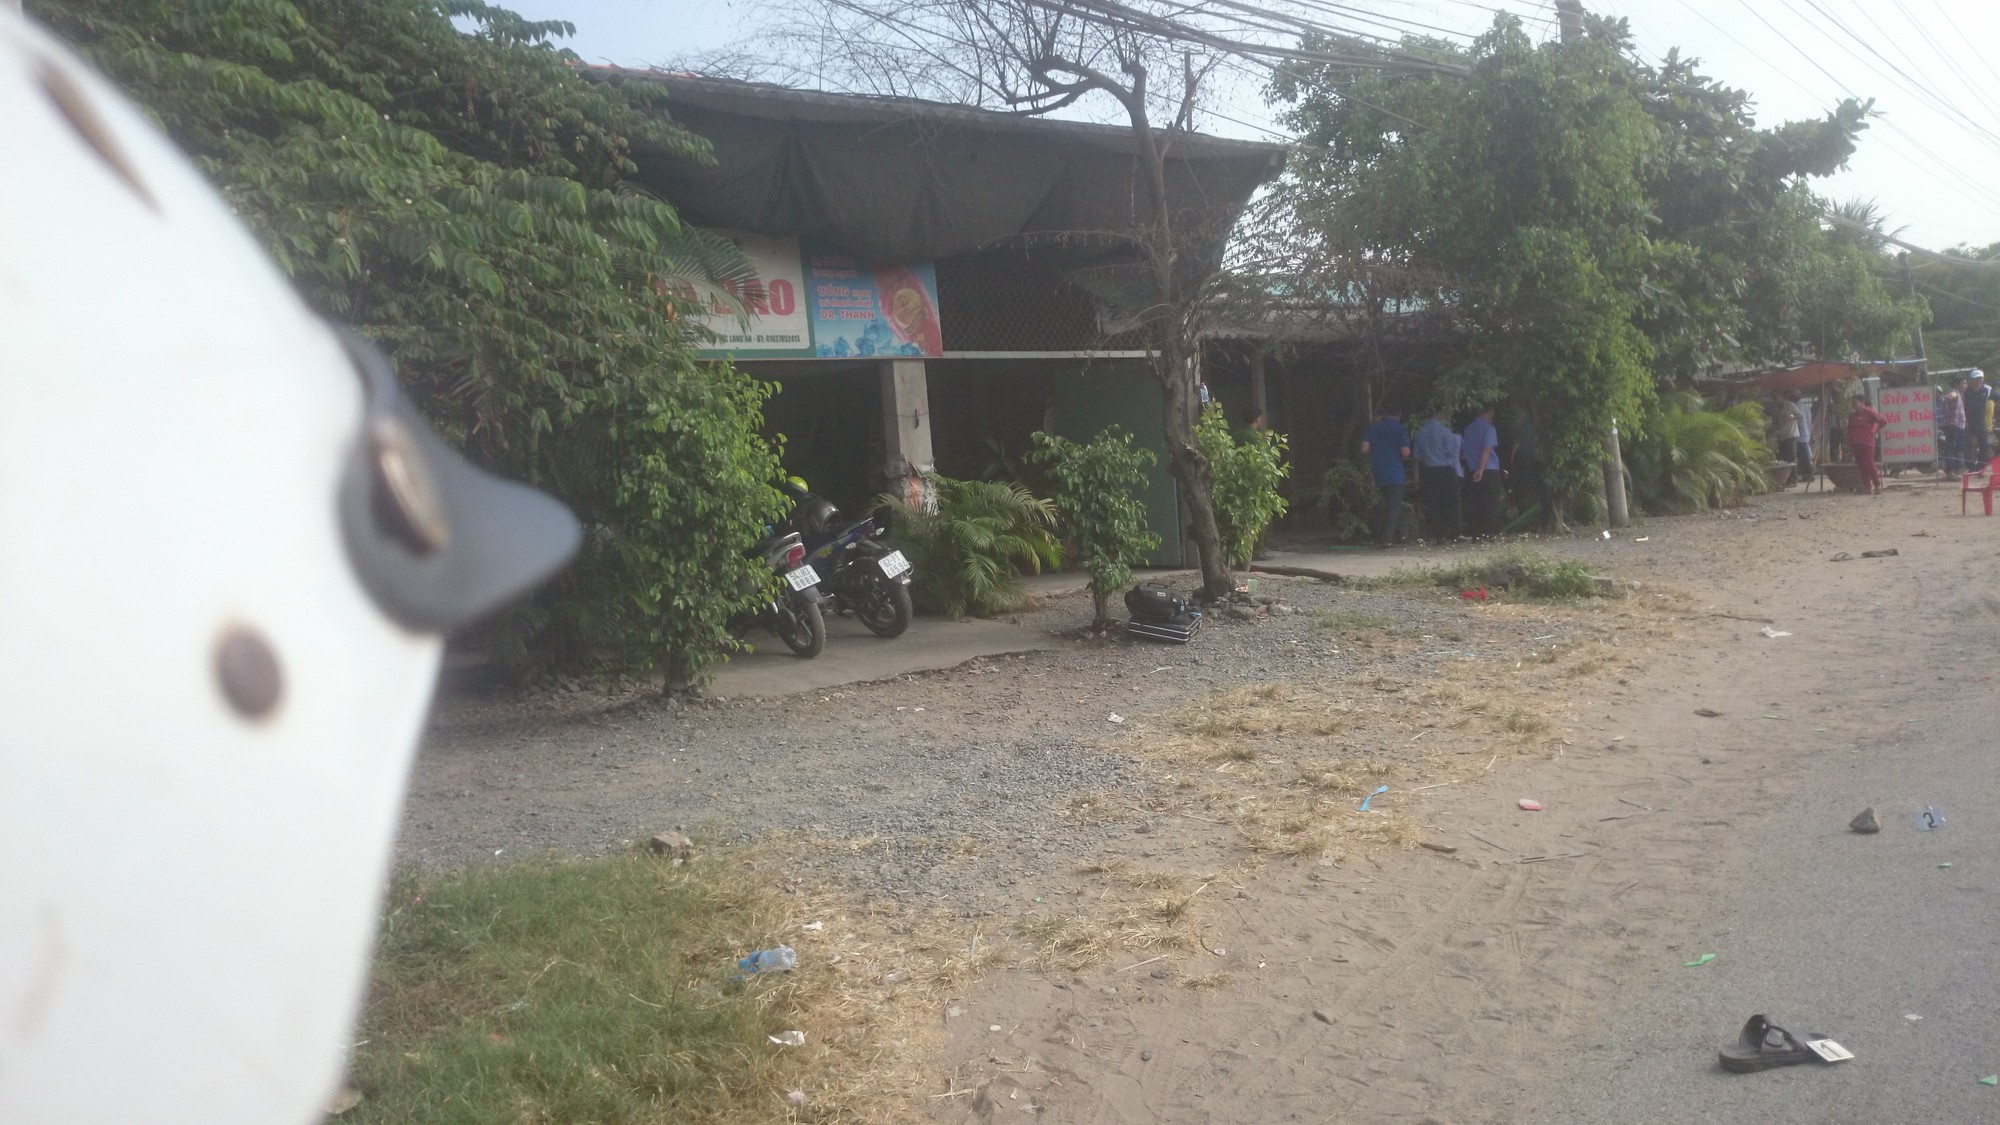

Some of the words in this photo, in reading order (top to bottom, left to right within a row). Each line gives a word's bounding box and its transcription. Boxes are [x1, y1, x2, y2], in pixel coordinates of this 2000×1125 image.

[820, 310, 838, 320] DR.
[839, 310, 875, 320] THANH
[1912, 390, 1930, 402] Xe
[794, 574, 817, 589] 8888
[1922, 812, 1938, 829] 2
